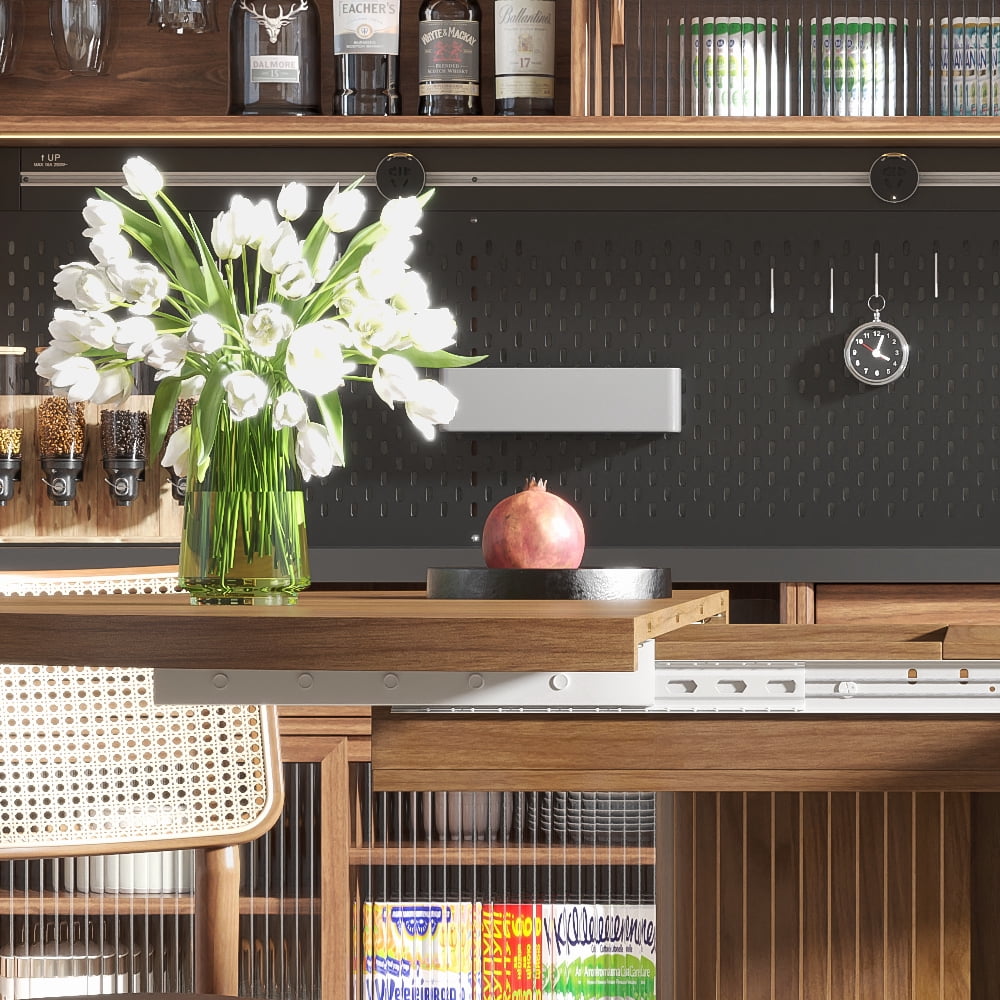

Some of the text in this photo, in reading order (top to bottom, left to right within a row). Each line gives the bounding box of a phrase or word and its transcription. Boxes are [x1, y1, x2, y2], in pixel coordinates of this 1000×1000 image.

[421, 28, 443, 46] WHYTE
[253, 60, 296, 69] DALMORE
[520, 58, 531, 68] 17
[47, 153, 61, 162] UP
